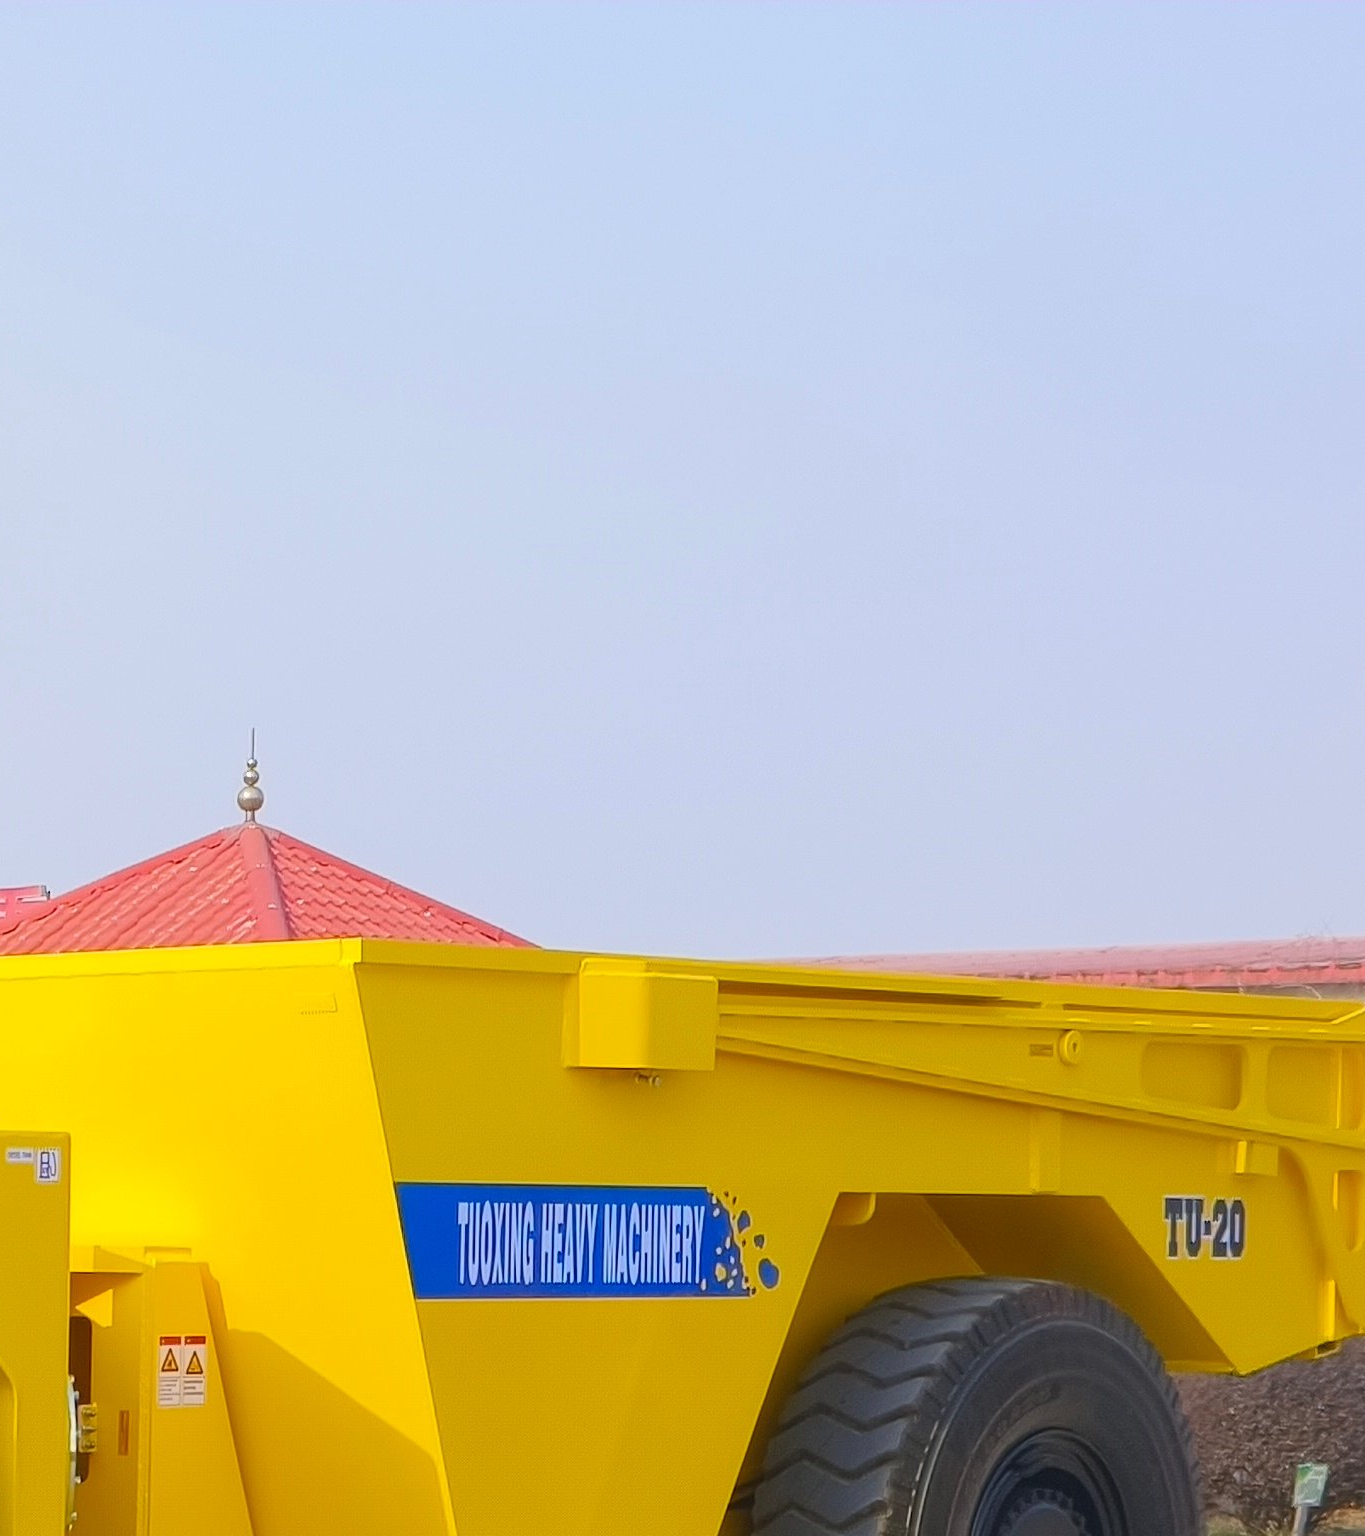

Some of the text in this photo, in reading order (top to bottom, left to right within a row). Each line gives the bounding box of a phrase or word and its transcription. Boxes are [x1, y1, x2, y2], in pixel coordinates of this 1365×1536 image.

[457, 1200, 706, 1286] TUOXING HEAVY MACHINERY
[1164, 1197, 1246, 1258] TU-20
